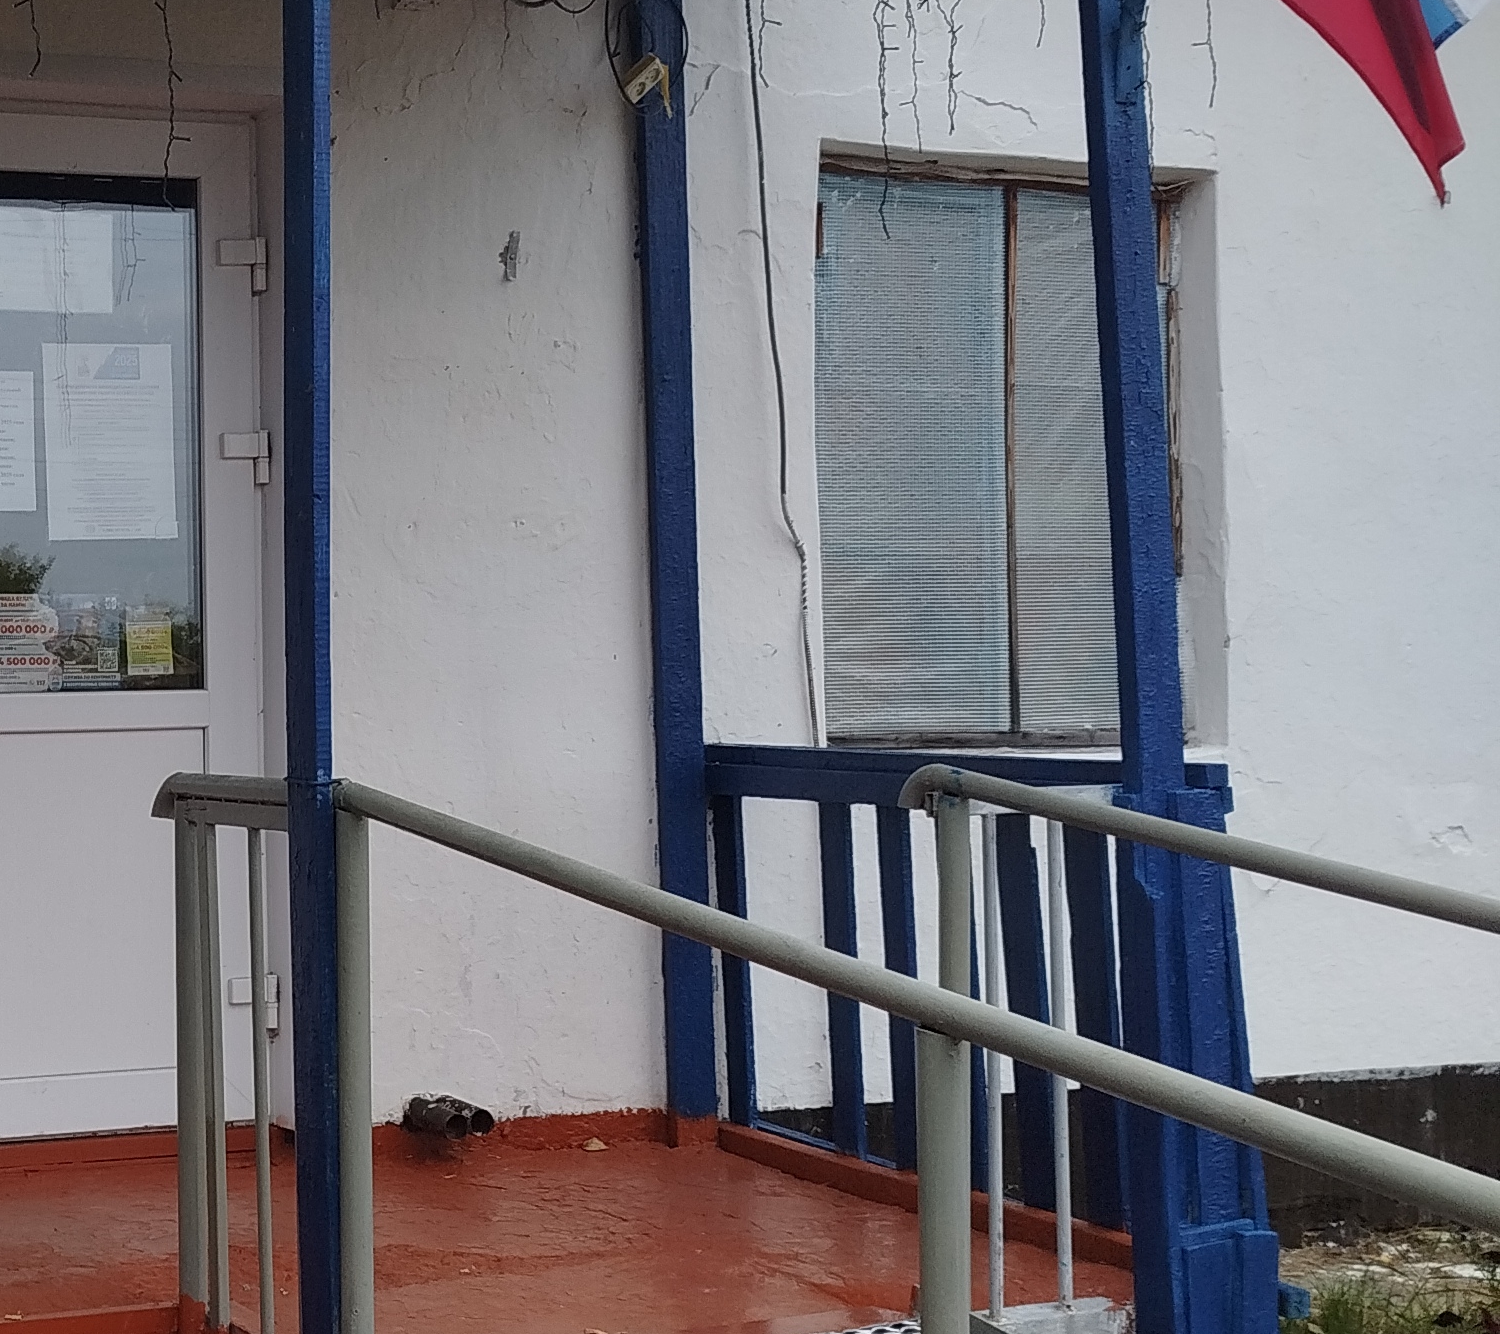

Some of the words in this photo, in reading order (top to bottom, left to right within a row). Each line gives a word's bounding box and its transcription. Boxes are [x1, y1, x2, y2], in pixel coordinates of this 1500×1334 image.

[0, 624, 23, 634] 000
[24, 624, 47, 634] 000
[6, 657, 27, 665] 500
[28, 656, 50, 665] 000
